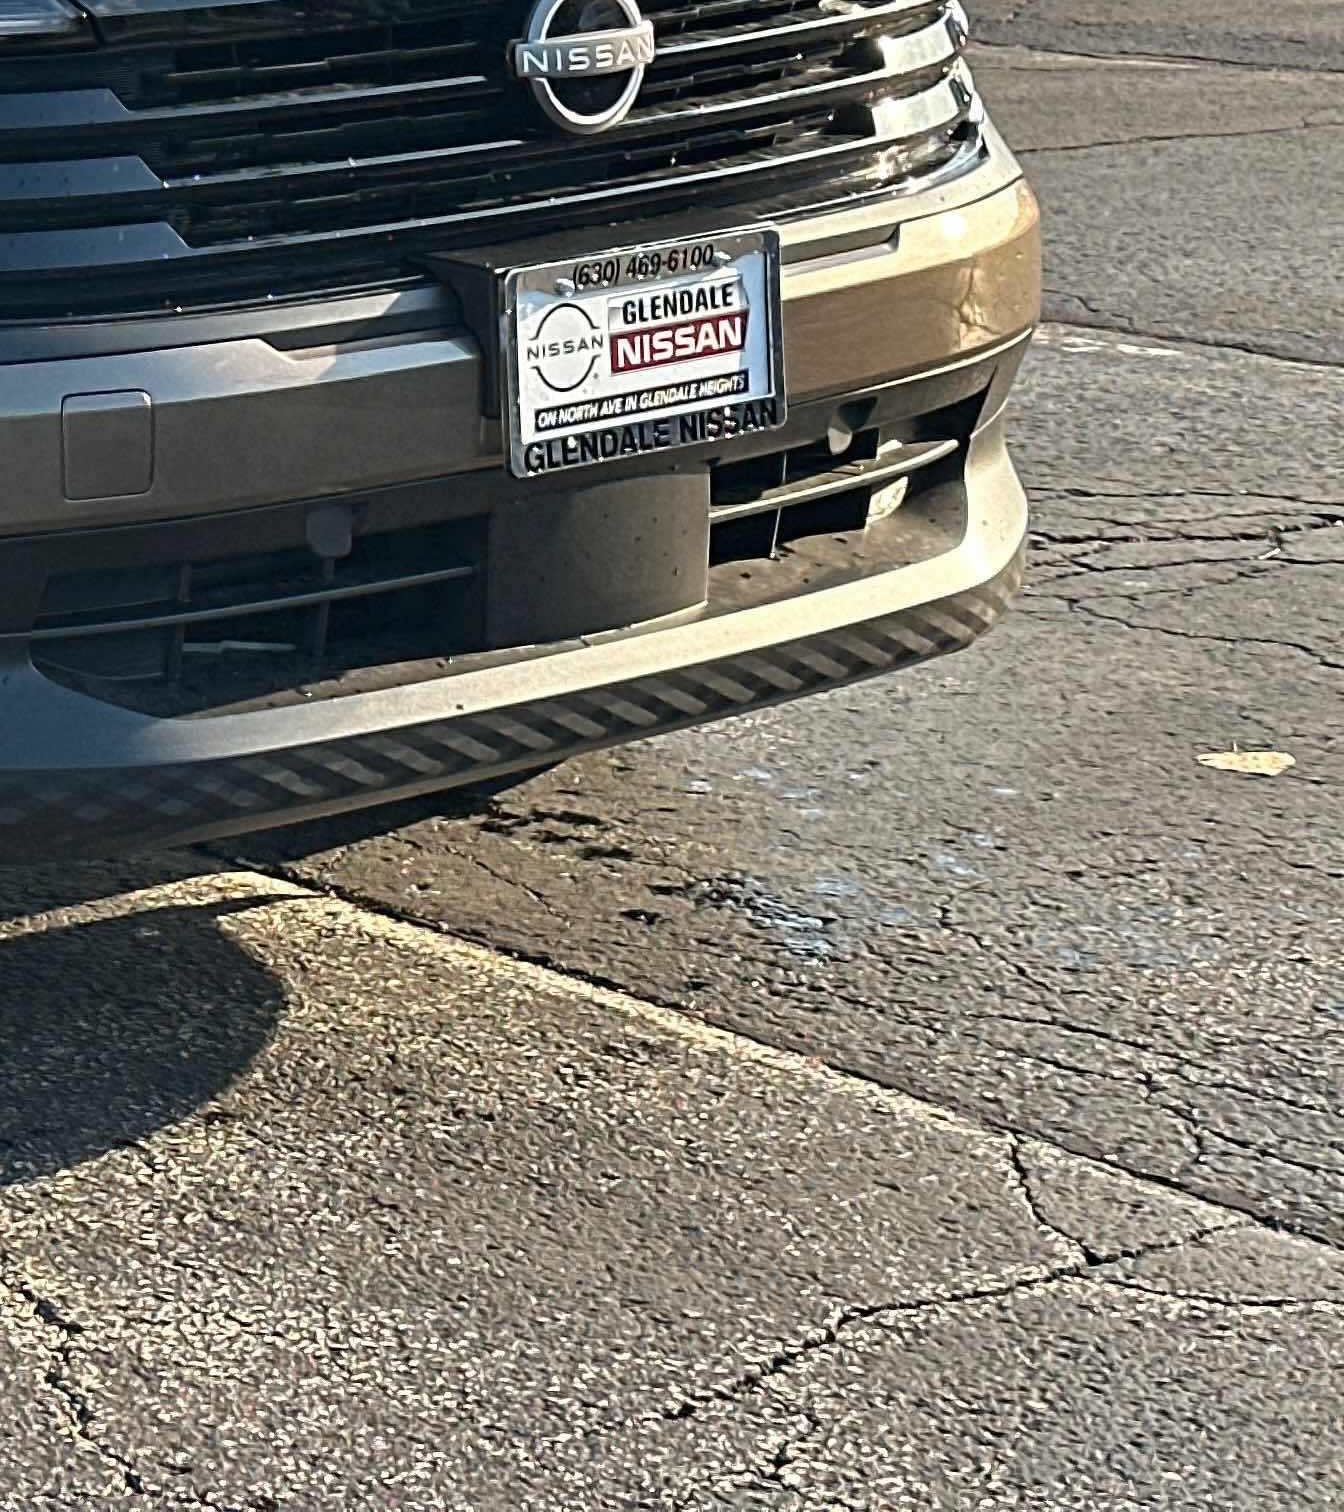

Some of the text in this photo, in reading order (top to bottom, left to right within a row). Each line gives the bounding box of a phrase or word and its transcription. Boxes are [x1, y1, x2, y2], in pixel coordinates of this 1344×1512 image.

[522, 33, 652, 73] NISSAN
[572, 245, 714, 287] (630) 469-6100
[622, 282, 735, 326] GLENDALE
[527, 335, 604, 362] NISSAN
[616, 317, 743, 368] NISSAN
[537, 374, 746, 428] ON NORTH AVE IN GLENDALE HEIGHTS
[523, 401, 777, 474] GLENDALE NISSAN
